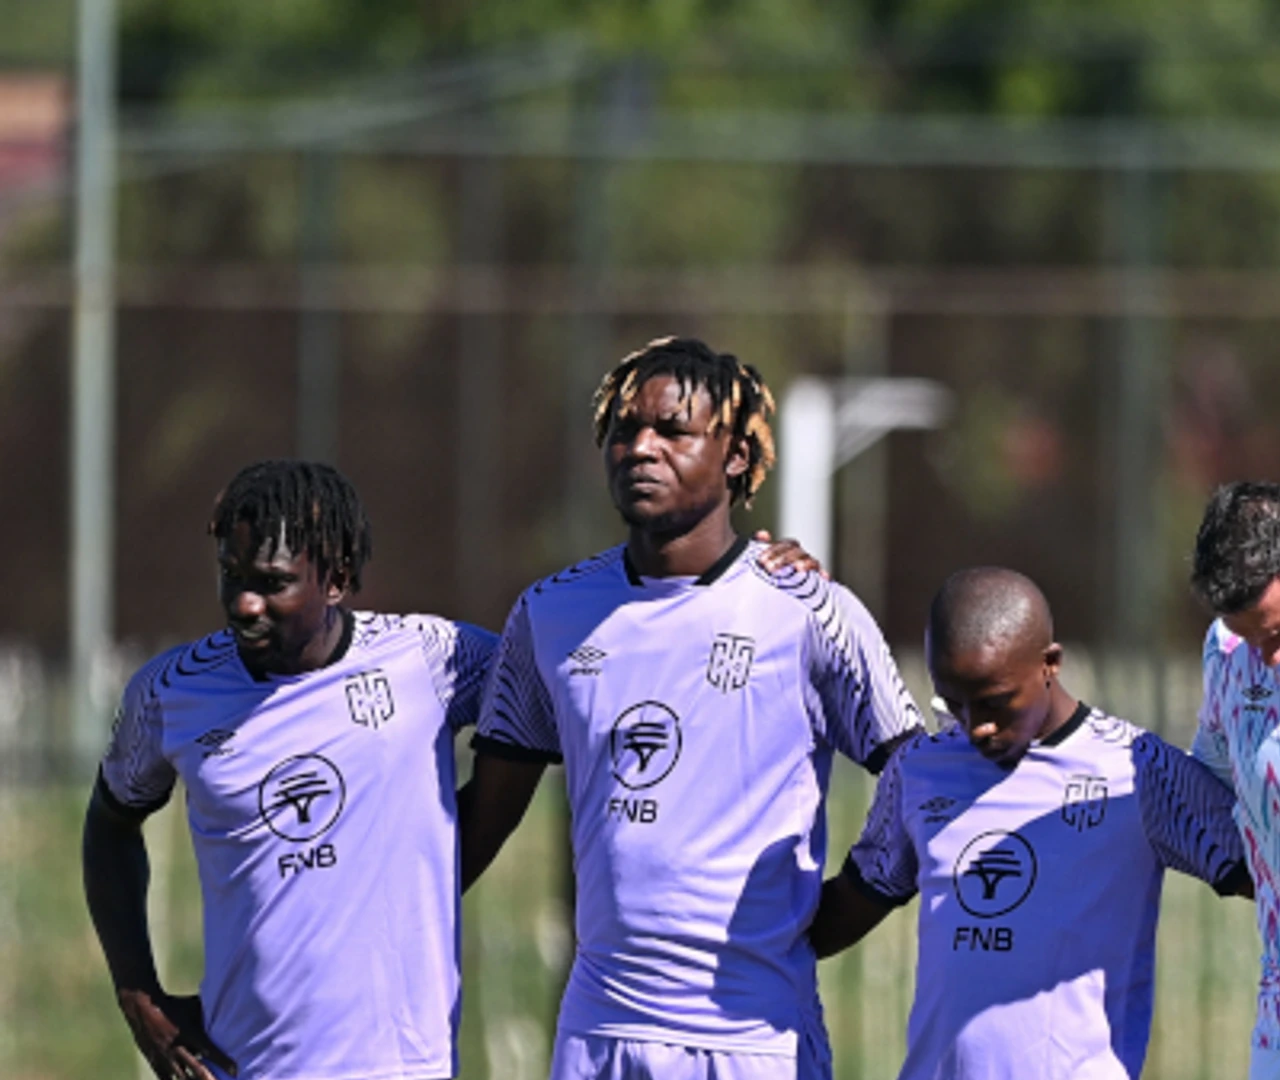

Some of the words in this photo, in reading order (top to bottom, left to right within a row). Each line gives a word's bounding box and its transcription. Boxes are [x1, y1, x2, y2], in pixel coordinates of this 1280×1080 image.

[606, 799, 658, 823] FNB
[277, 843, 337, 878] FNB
[953, 927, 1013, 951] FNB
